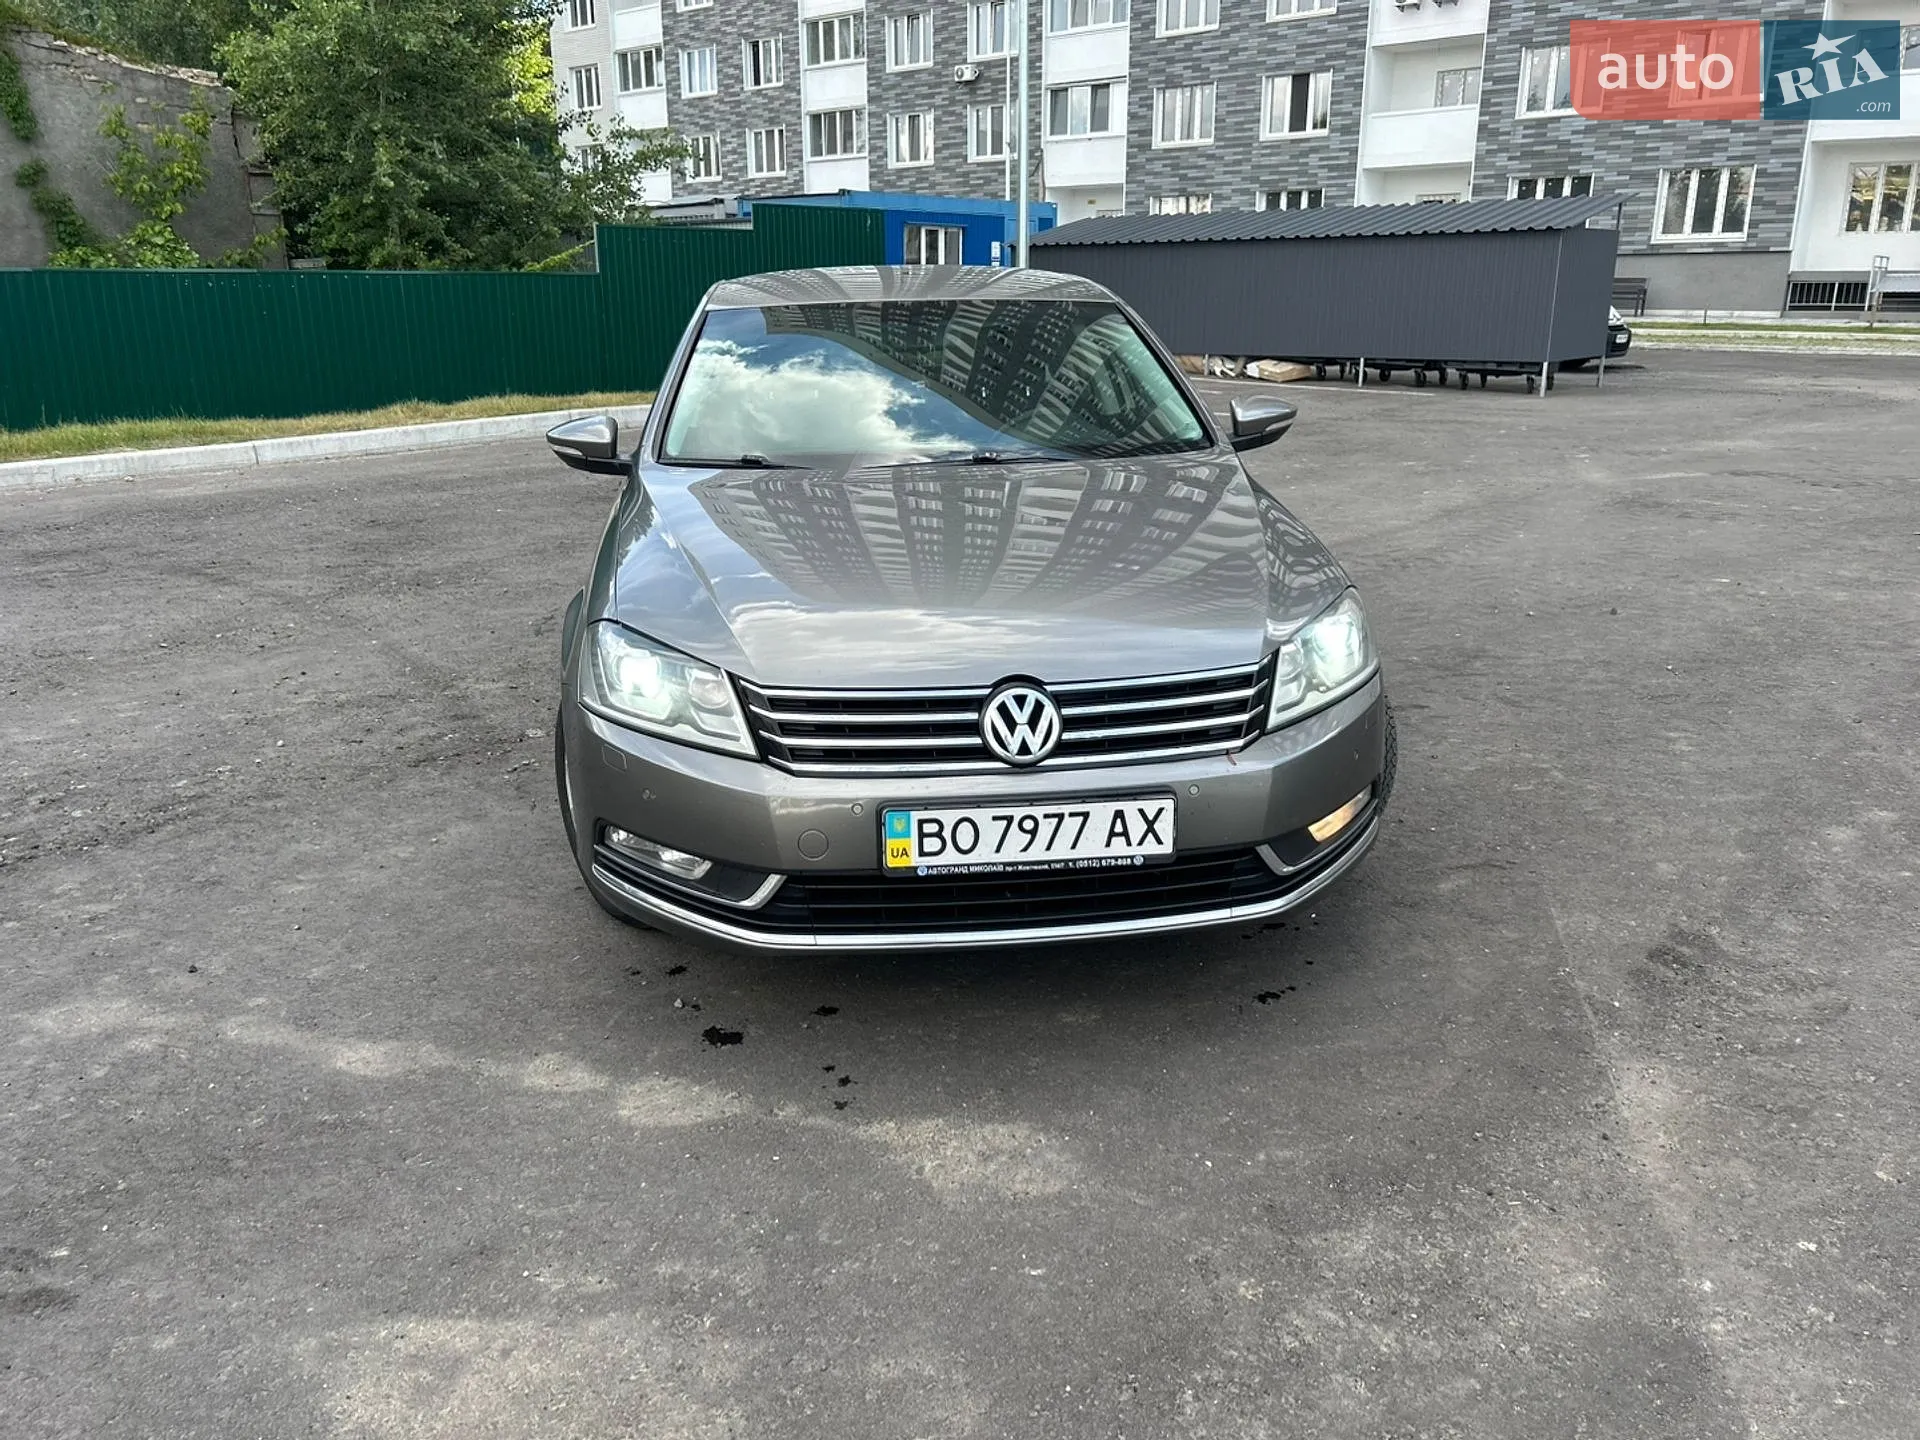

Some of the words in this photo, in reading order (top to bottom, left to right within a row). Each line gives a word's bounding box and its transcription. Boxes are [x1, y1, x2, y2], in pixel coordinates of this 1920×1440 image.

[916, 815, 980, 858] BO
[991, 811, 1091, 854] 7977
[1105, 807, 1166, 848] AX
[890, 847, 910, 859] UA
